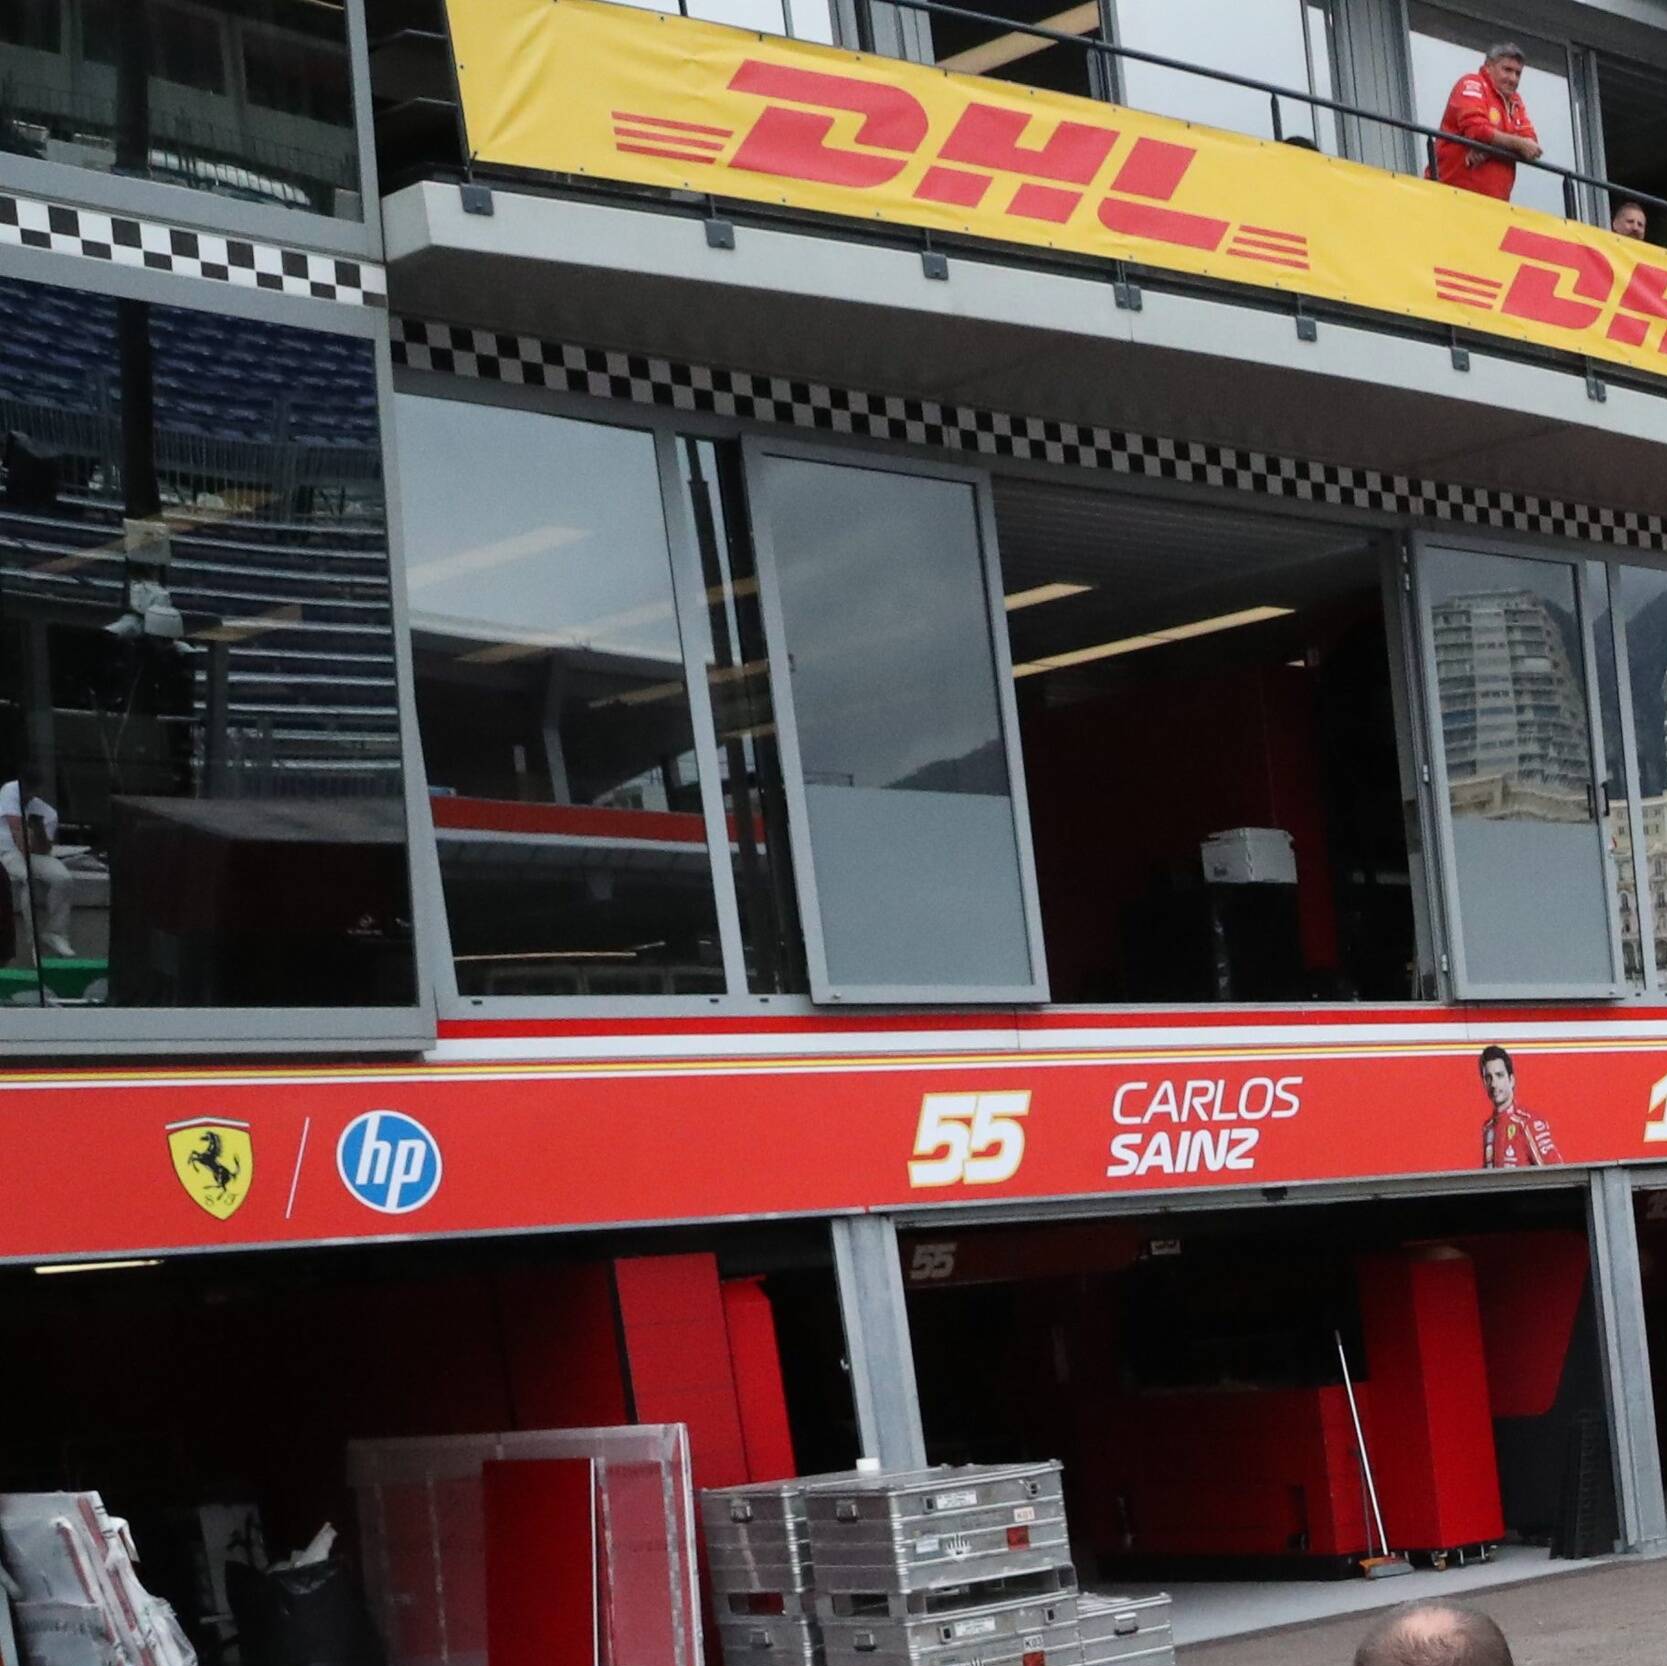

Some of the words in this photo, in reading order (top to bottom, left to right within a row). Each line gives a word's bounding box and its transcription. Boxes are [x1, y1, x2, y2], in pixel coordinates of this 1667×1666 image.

[727, 59, 1228, 252] DHL
[1112, 1076, 1303, 1125] CARLOS
[355, 1115, 426, 1208] hp
[907, 1090, 1032, 1188] 55
[1106, 1128, 1260, 1178] SAINZ
[910, 1242, 957, 1280] 55
